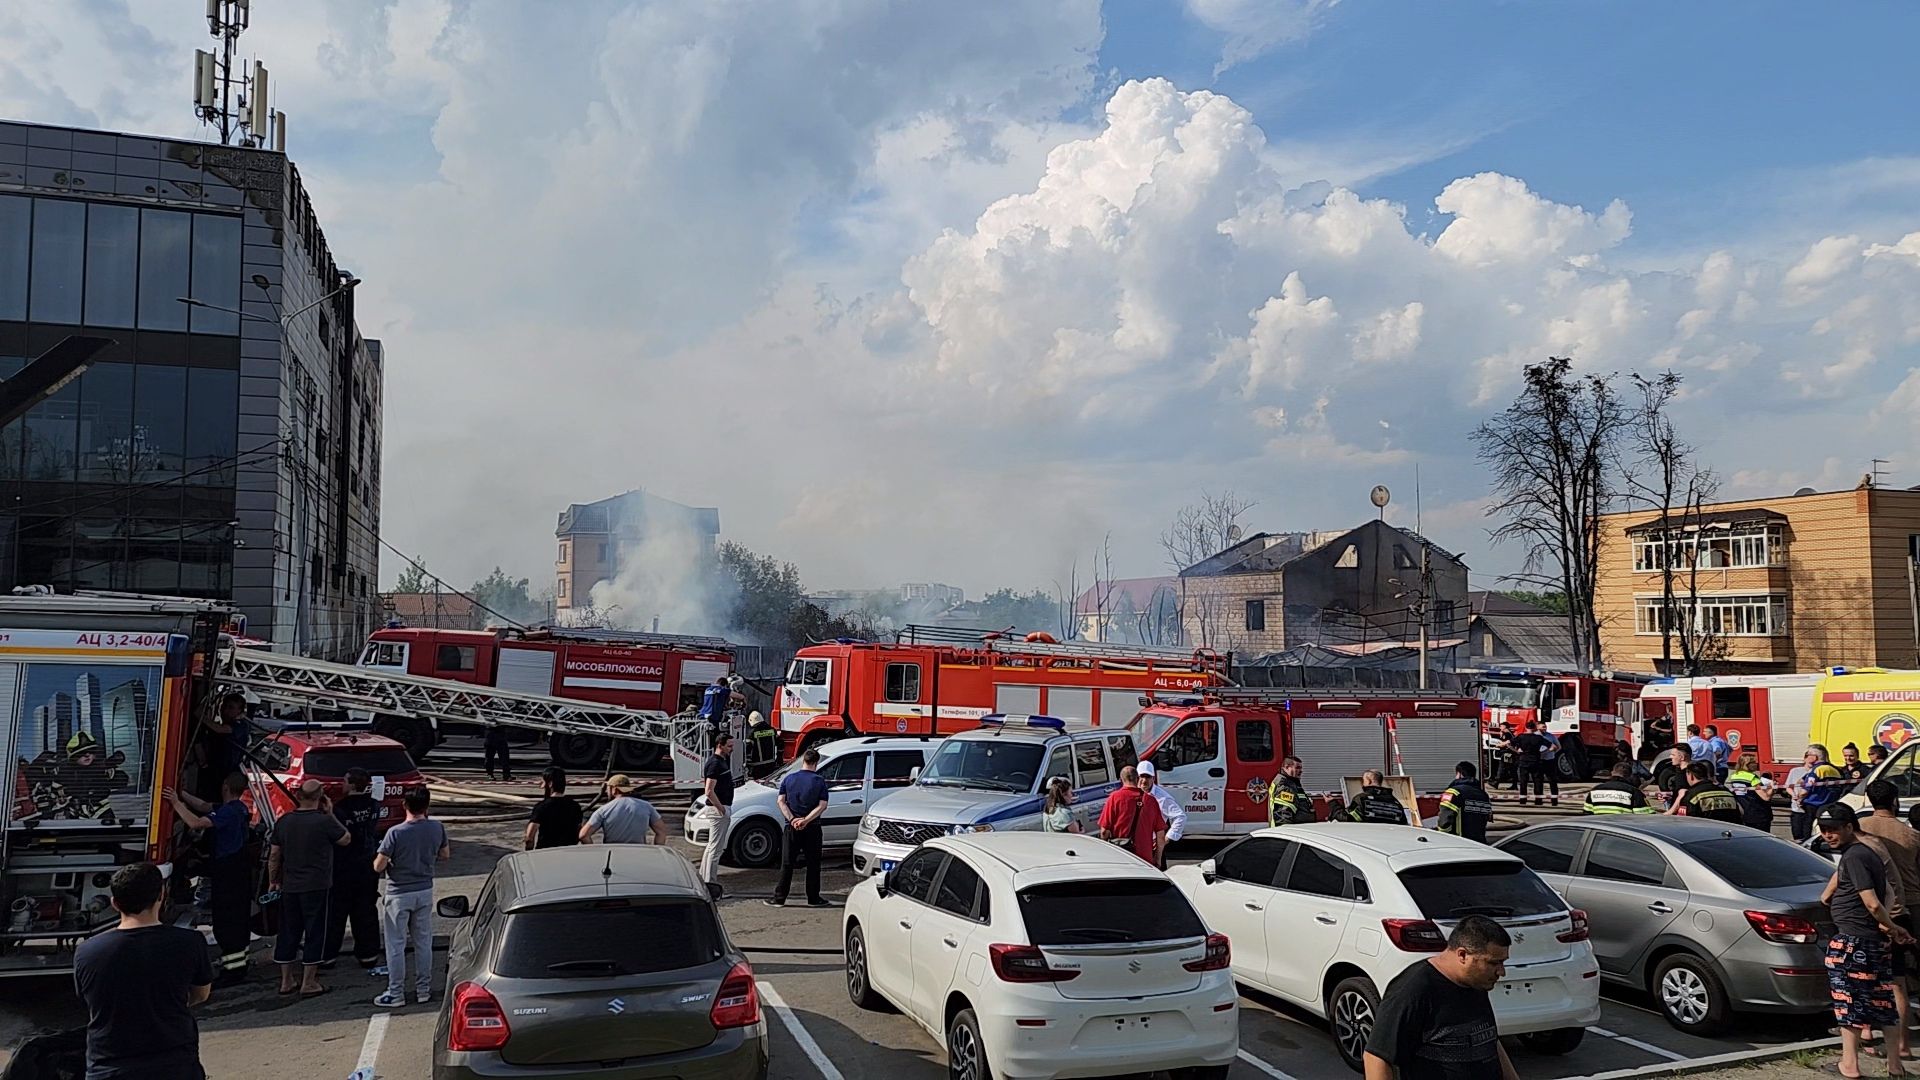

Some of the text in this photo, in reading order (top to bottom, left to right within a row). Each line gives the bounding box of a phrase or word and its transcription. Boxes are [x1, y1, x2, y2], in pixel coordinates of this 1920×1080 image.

[77, 634, 166, 647] АЦ 3,2-40/4
[566, 661, 663, 676] МОСОБЛПОЖСПАС
[1154, 678, 1168, 687] АЦ
[786, 696, 801, 708] 313
[1562, 708, 1574, 717] 96
[677, 748, 700, 763] MAGIRU
[385, 785, 403, 795] 308
[1191, 791, 1209, 801] 244
[1184, 804, 1217, 813] ГОЛИЦЫНО
[681, 994, 711, 1004] SWIFT
